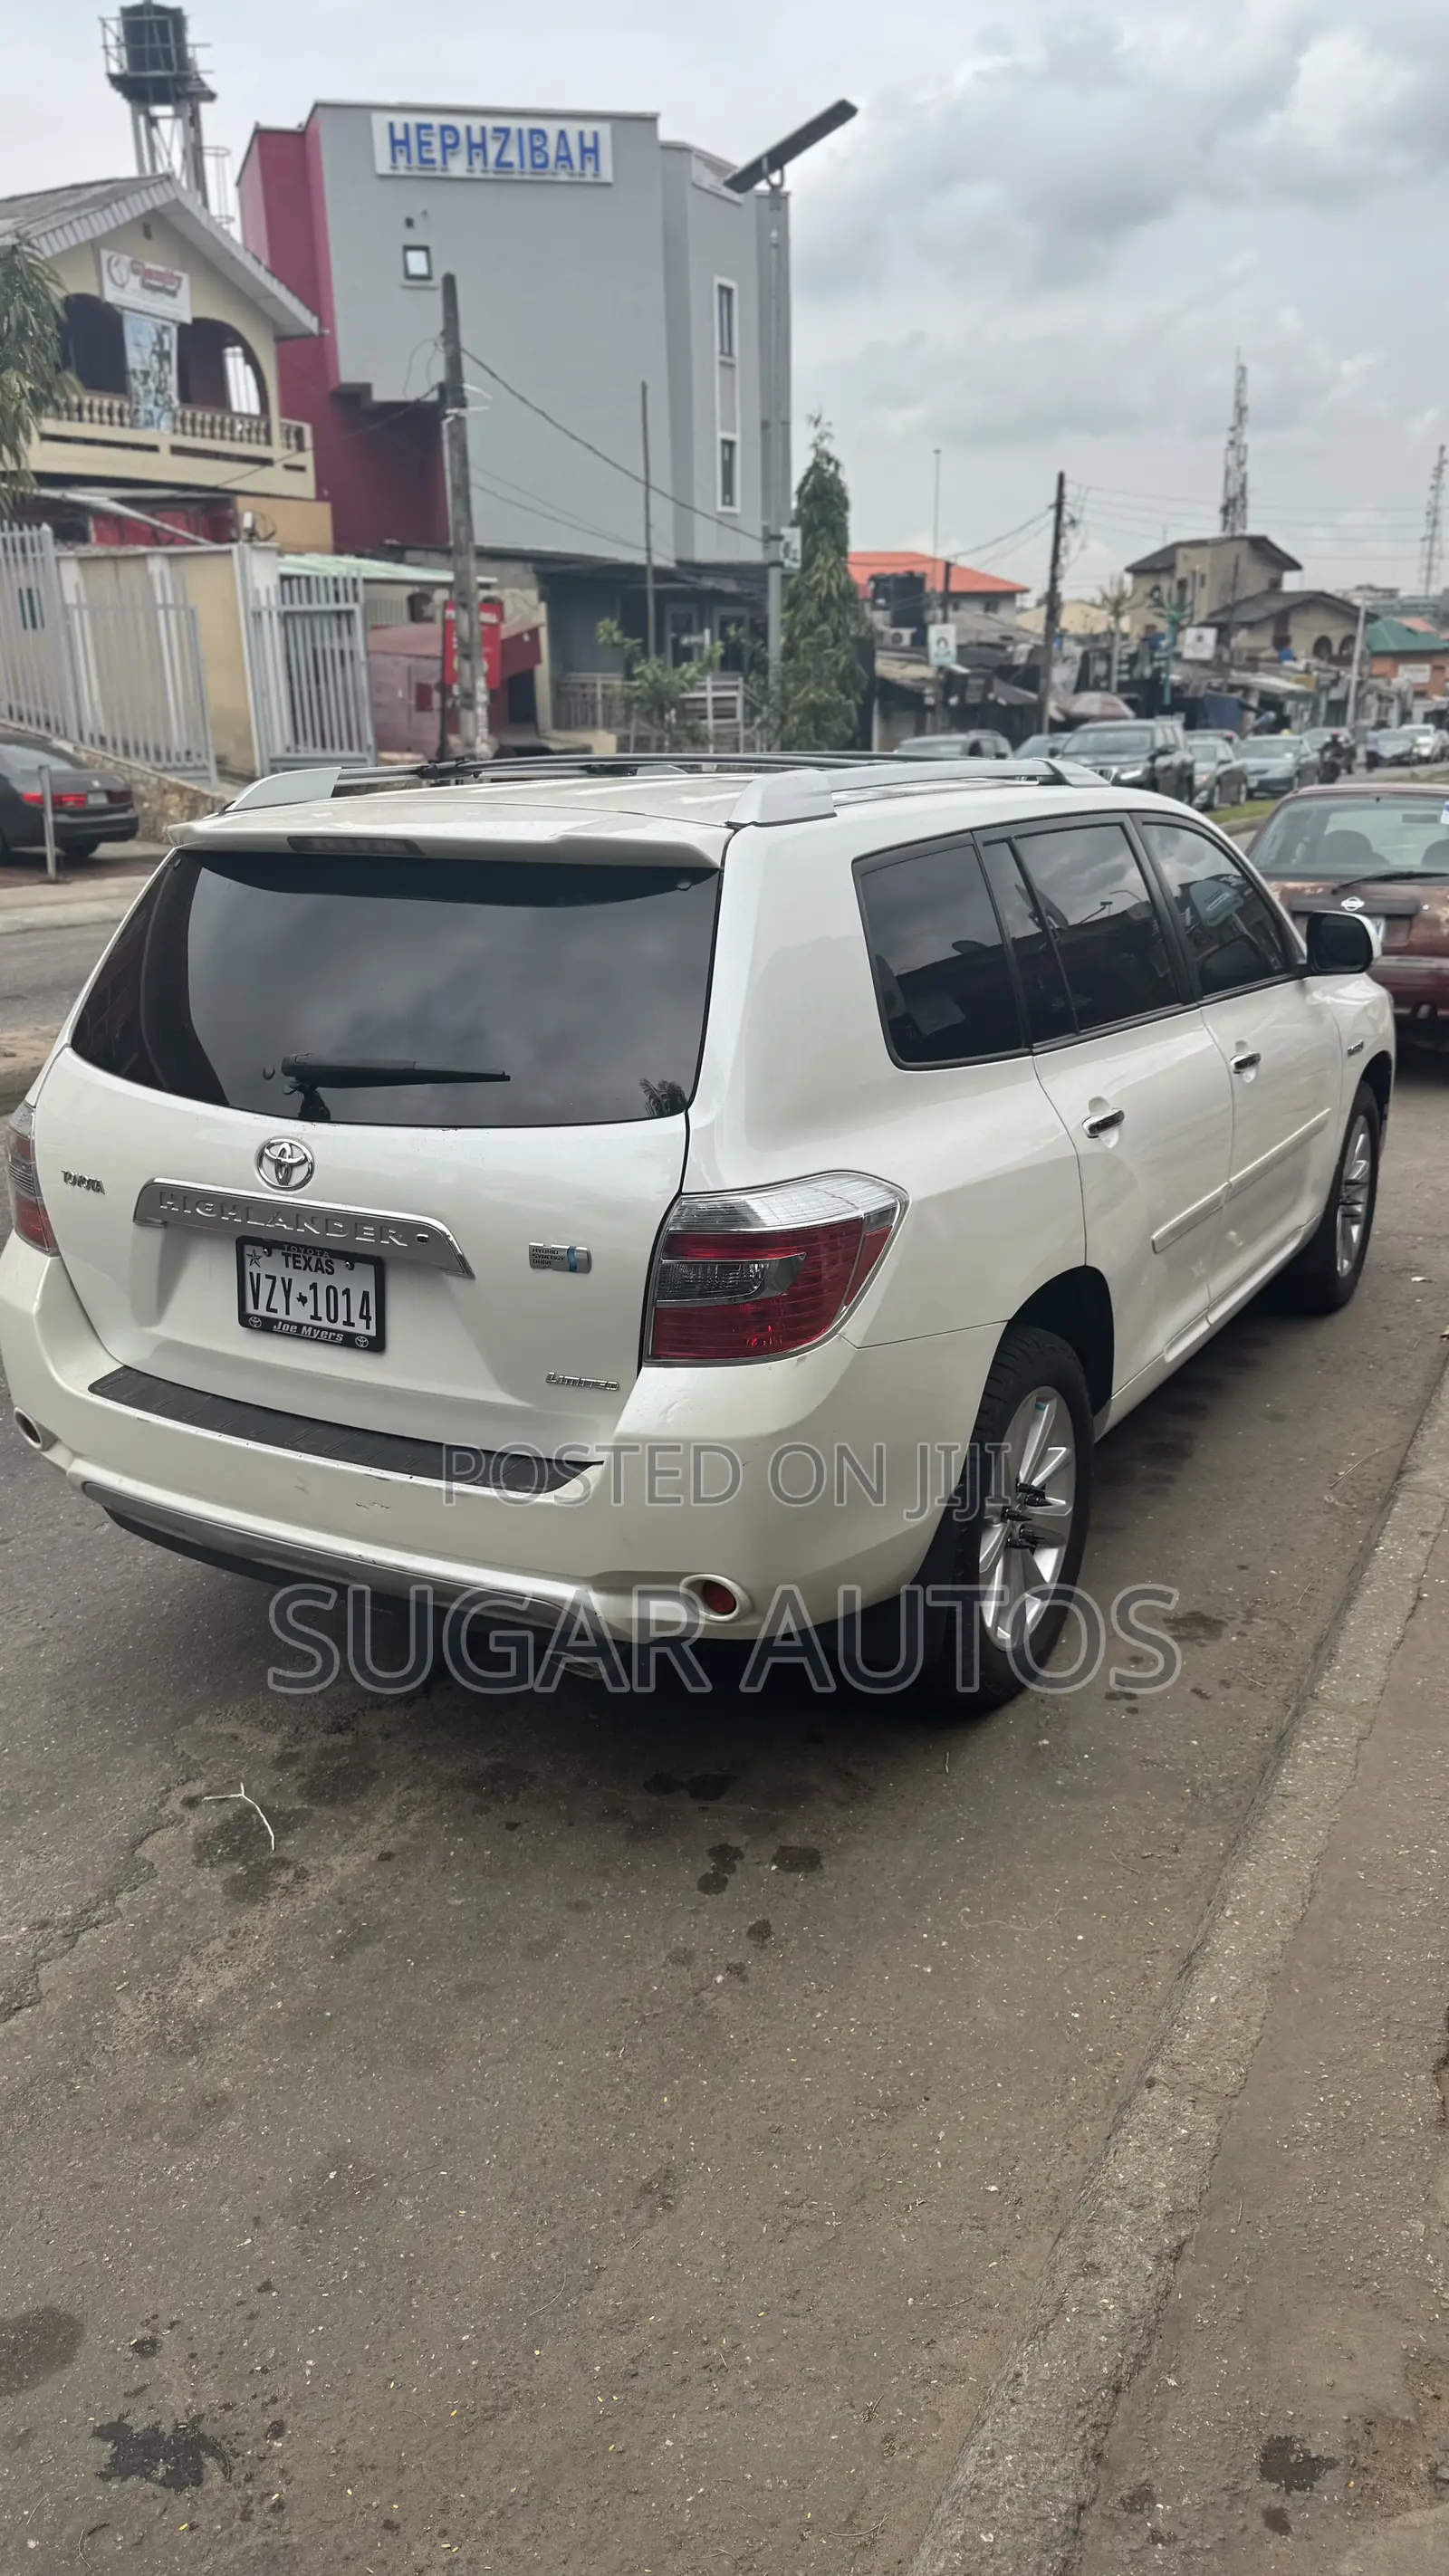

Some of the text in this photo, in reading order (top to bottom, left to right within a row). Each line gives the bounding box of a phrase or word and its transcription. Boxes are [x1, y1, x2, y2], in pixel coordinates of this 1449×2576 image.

[387, 120, 600, 175] HEPHZIBAH
[61, 1169, 106, 1195] TOYOTA
[158, 1191, 408, 1247] HIGHLANDER
[282, 1252, 335, 1276] TEXAS
[283, 1244, 331, 1259] TOYOTA
[273, 1320, 344, 1343] Joe Myers
